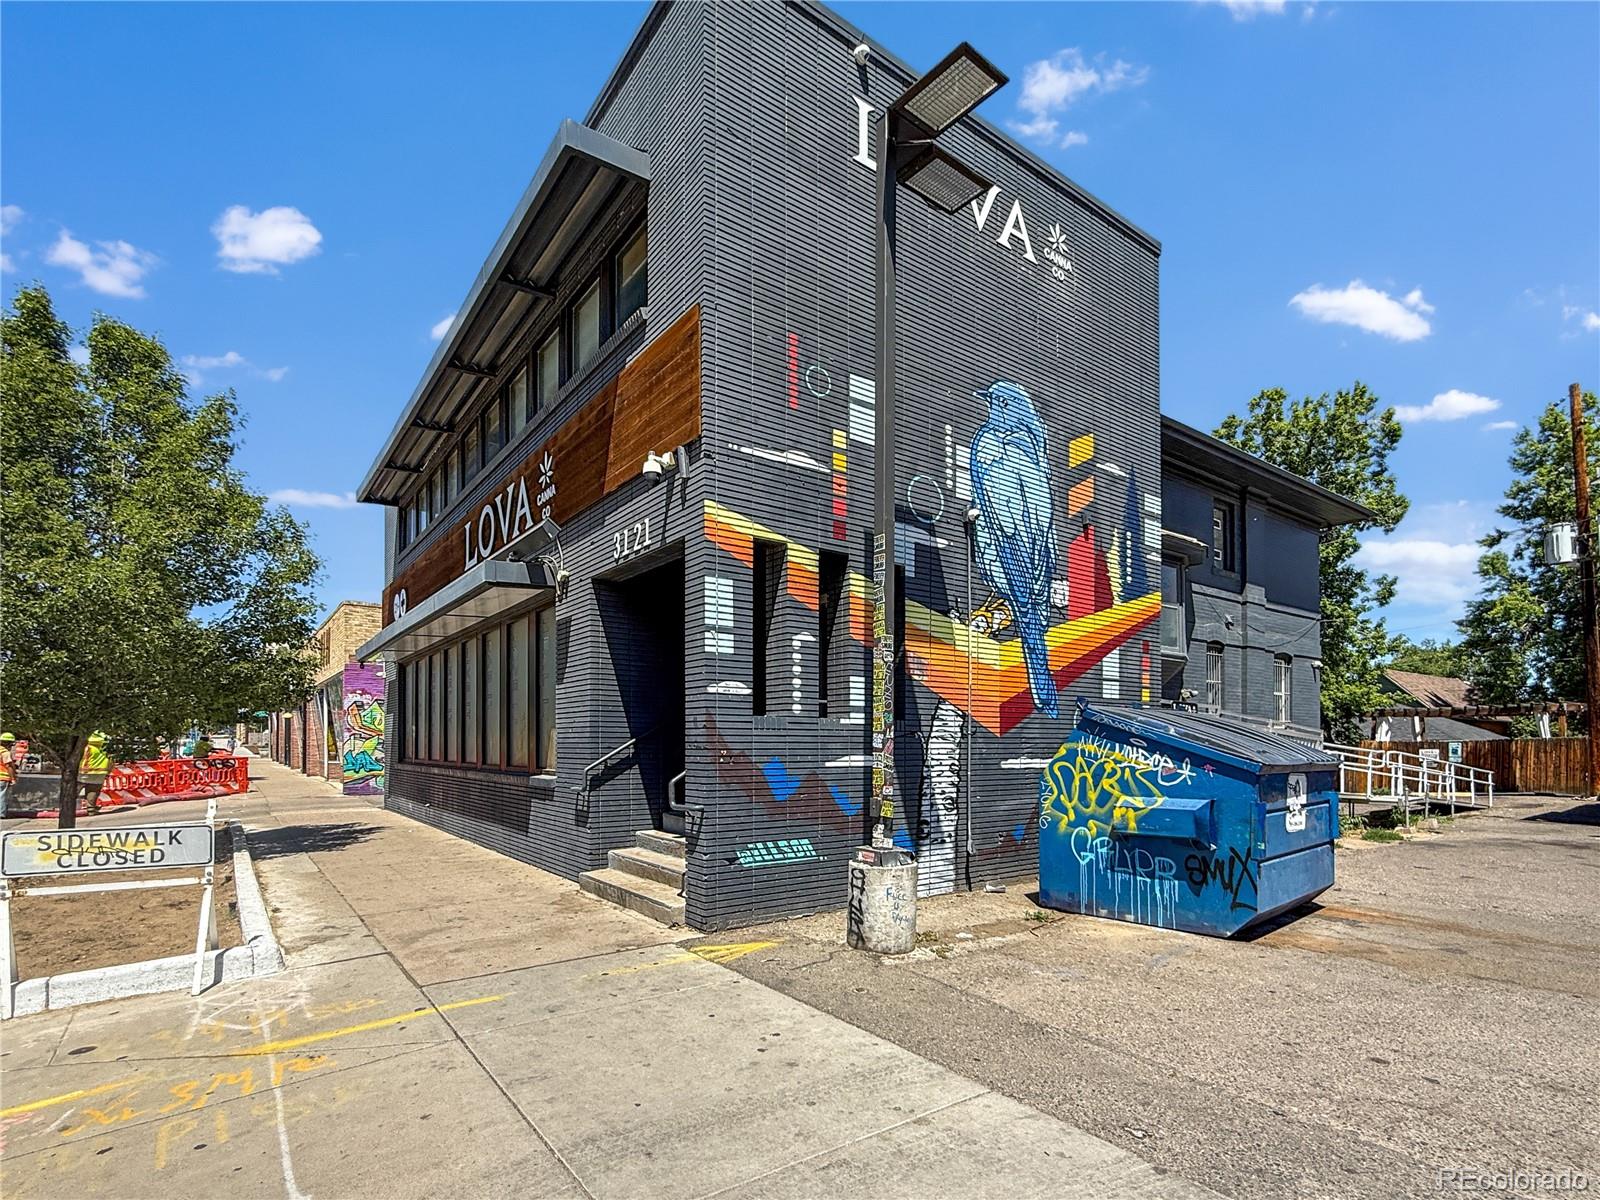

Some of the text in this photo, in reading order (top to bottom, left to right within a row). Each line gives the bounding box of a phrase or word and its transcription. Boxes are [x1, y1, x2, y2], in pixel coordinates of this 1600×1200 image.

[852, 94, 1038, 265] LVA
[1043, 248, 1073, 272] CANNA
[1052, 266, 1065, 281] CO
[464, 475, 534, 572] LOVA
[542, 505, 551, 520] CO
[613, 517, 651, 560] 3121
[37, 829, 183, 852] SIDEWALK
[57, 847, 165, 868] CLOSED
